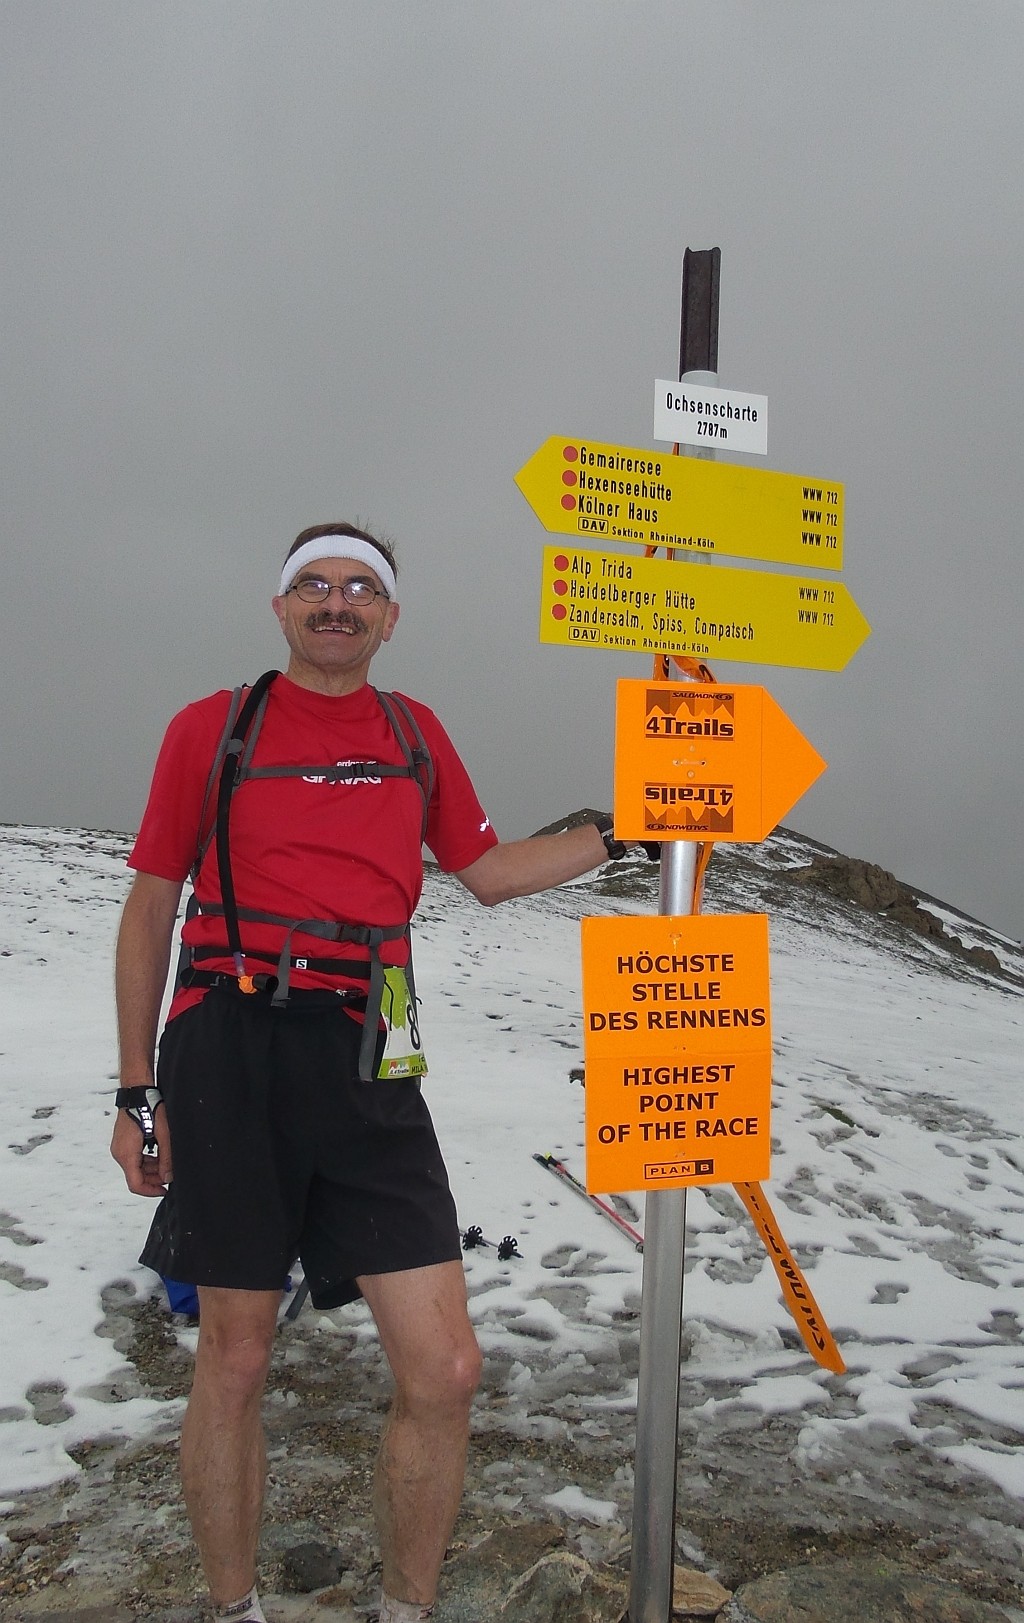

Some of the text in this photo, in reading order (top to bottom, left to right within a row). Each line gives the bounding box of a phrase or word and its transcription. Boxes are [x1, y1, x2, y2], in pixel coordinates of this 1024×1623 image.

[666, 393, 758, 422] Ochsenscharte
[697, 421, 728, 439] 2787m
[580, 447, 661, 477] Gemairersee
[579, 471, 672, 501] Hexenseehütte
[802, 487, 838, 505] WWW 712
[578, 495, 658, 523] Kölner Haus
[802, 509, 837, 527] WWW 712
[582, 519, 715, 549] DAV Sektion Rheinland-Köln
[801, 531, 837, 549] WWW 712
[572, 555, 633, 580] Alp Trida
[570, 580, 695, 610] Heidelberger Hütte
[799, 587, 835, 604] WWW 712
[569, 604, 754, 641] Zandersalm, Spiss, Compatsch
[798, 609, 834, 626] WWW 712
[573, 628, 709, 654] DAV Sektion Rheinland-Köln
[672, 692, 716, 700] SALOMON
[646, 716, 734, 737] 4Trails
[645, 787, 733, 806] 4Trails
[617, 951, 734, 974] HÖCHSTE
[632, 982, 721, 1001] STELLE
[590, 1008, 766, 1031] DES RENNENS
[623, 1065, 735, 1086] HIGHEST
[640, 1092, 719, 1113] POINT
[598, 1118, 758, 1144] OF THE RACE
[650, 1164, 710, 1175] PLAN B
